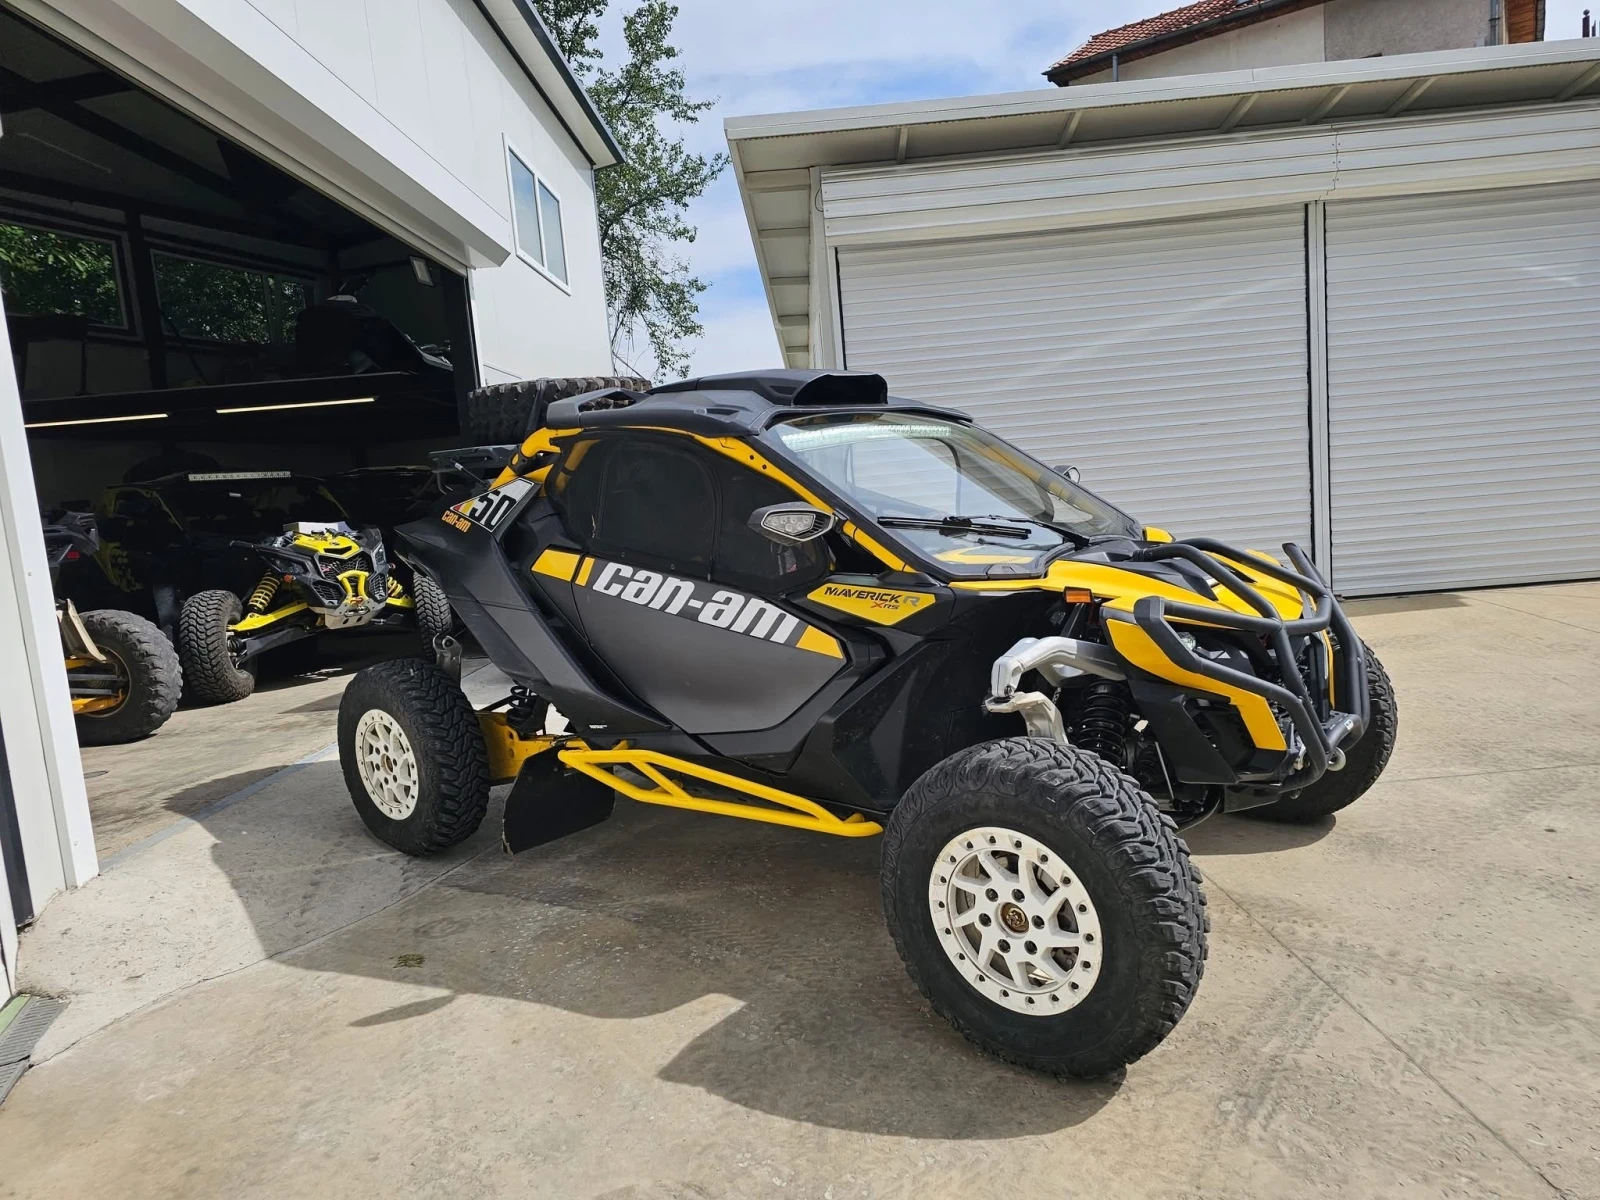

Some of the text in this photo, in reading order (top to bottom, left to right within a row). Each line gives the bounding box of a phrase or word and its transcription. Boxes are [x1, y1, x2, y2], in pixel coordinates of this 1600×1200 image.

[441, 510, 472, 533] can-am
[469, 489, 517, 530] 50
[592, 562, 800, 644] can-am
[824, 586, 904, 604] MAVERICK
